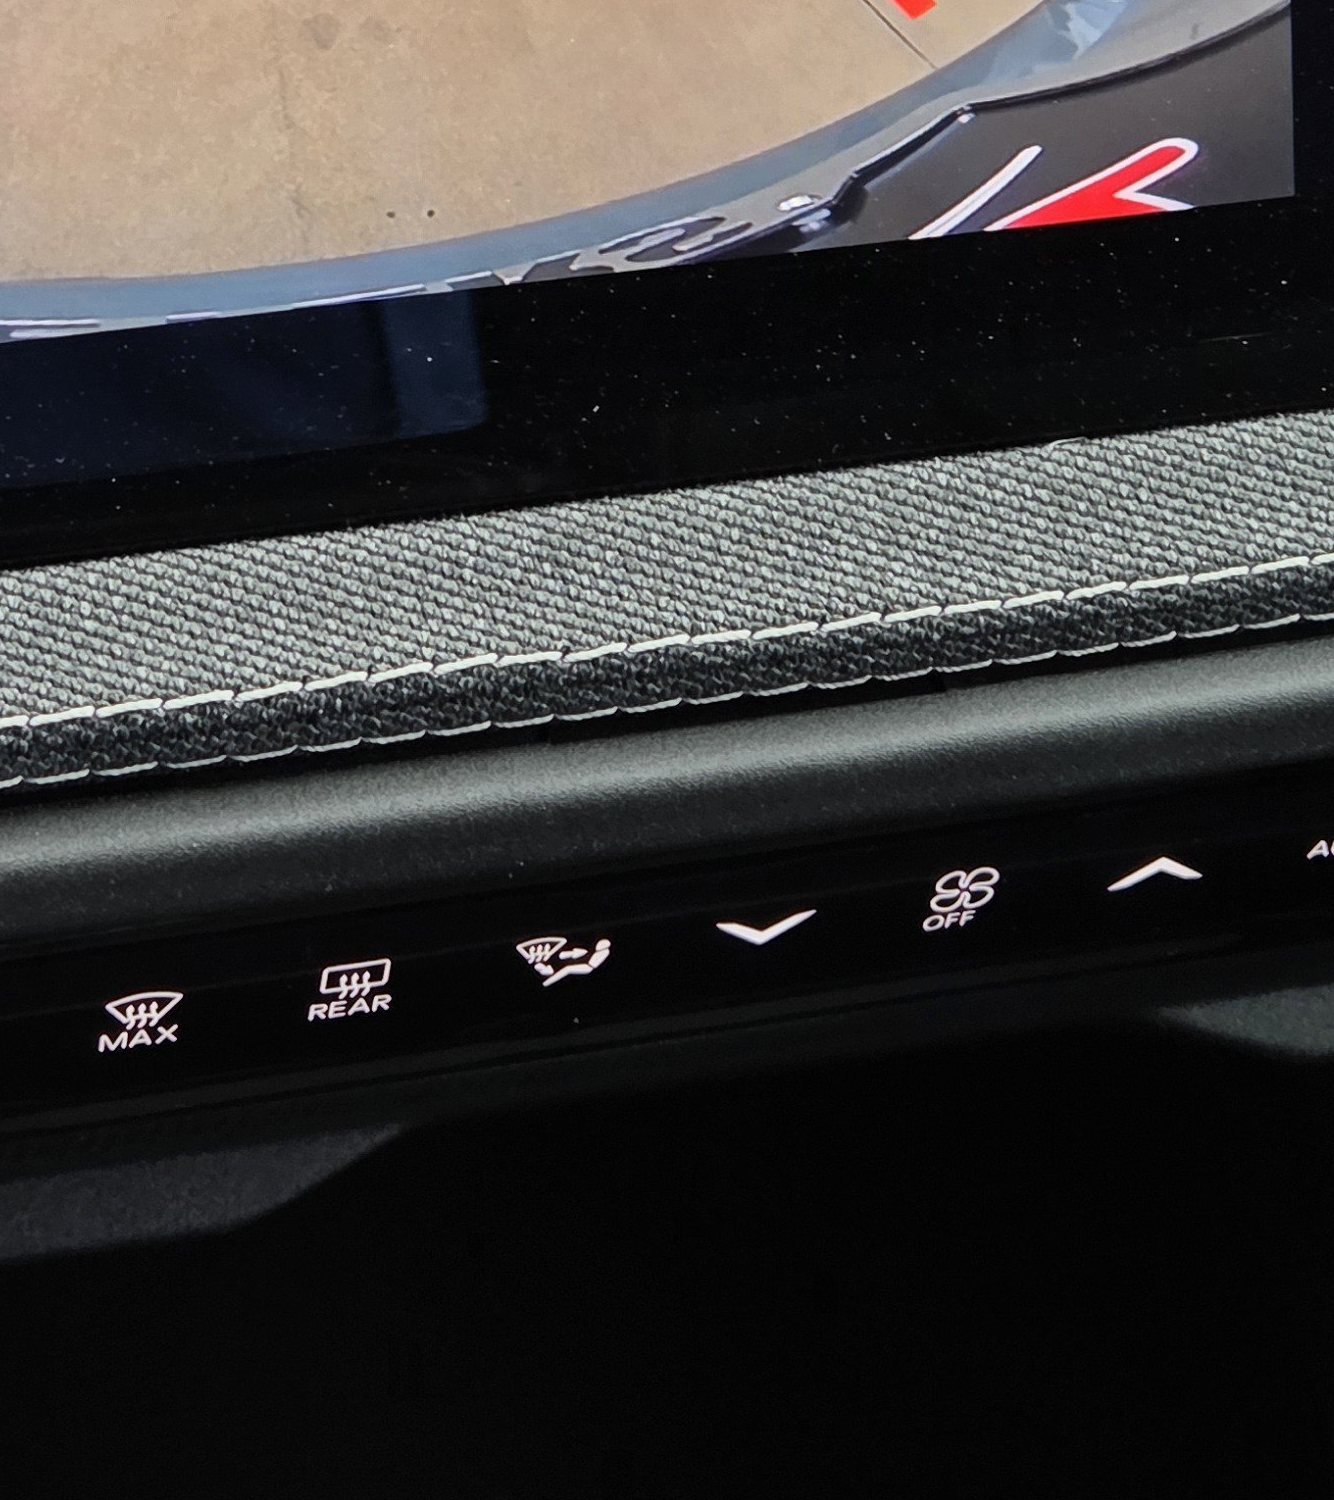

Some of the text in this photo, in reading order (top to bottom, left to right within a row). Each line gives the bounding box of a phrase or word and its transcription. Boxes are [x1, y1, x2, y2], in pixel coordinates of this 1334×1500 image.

[922, 909, 977, 932] OFF
[307, 993, 393, 1022] REAR
[98, 1023, 180, 1053] MAX
